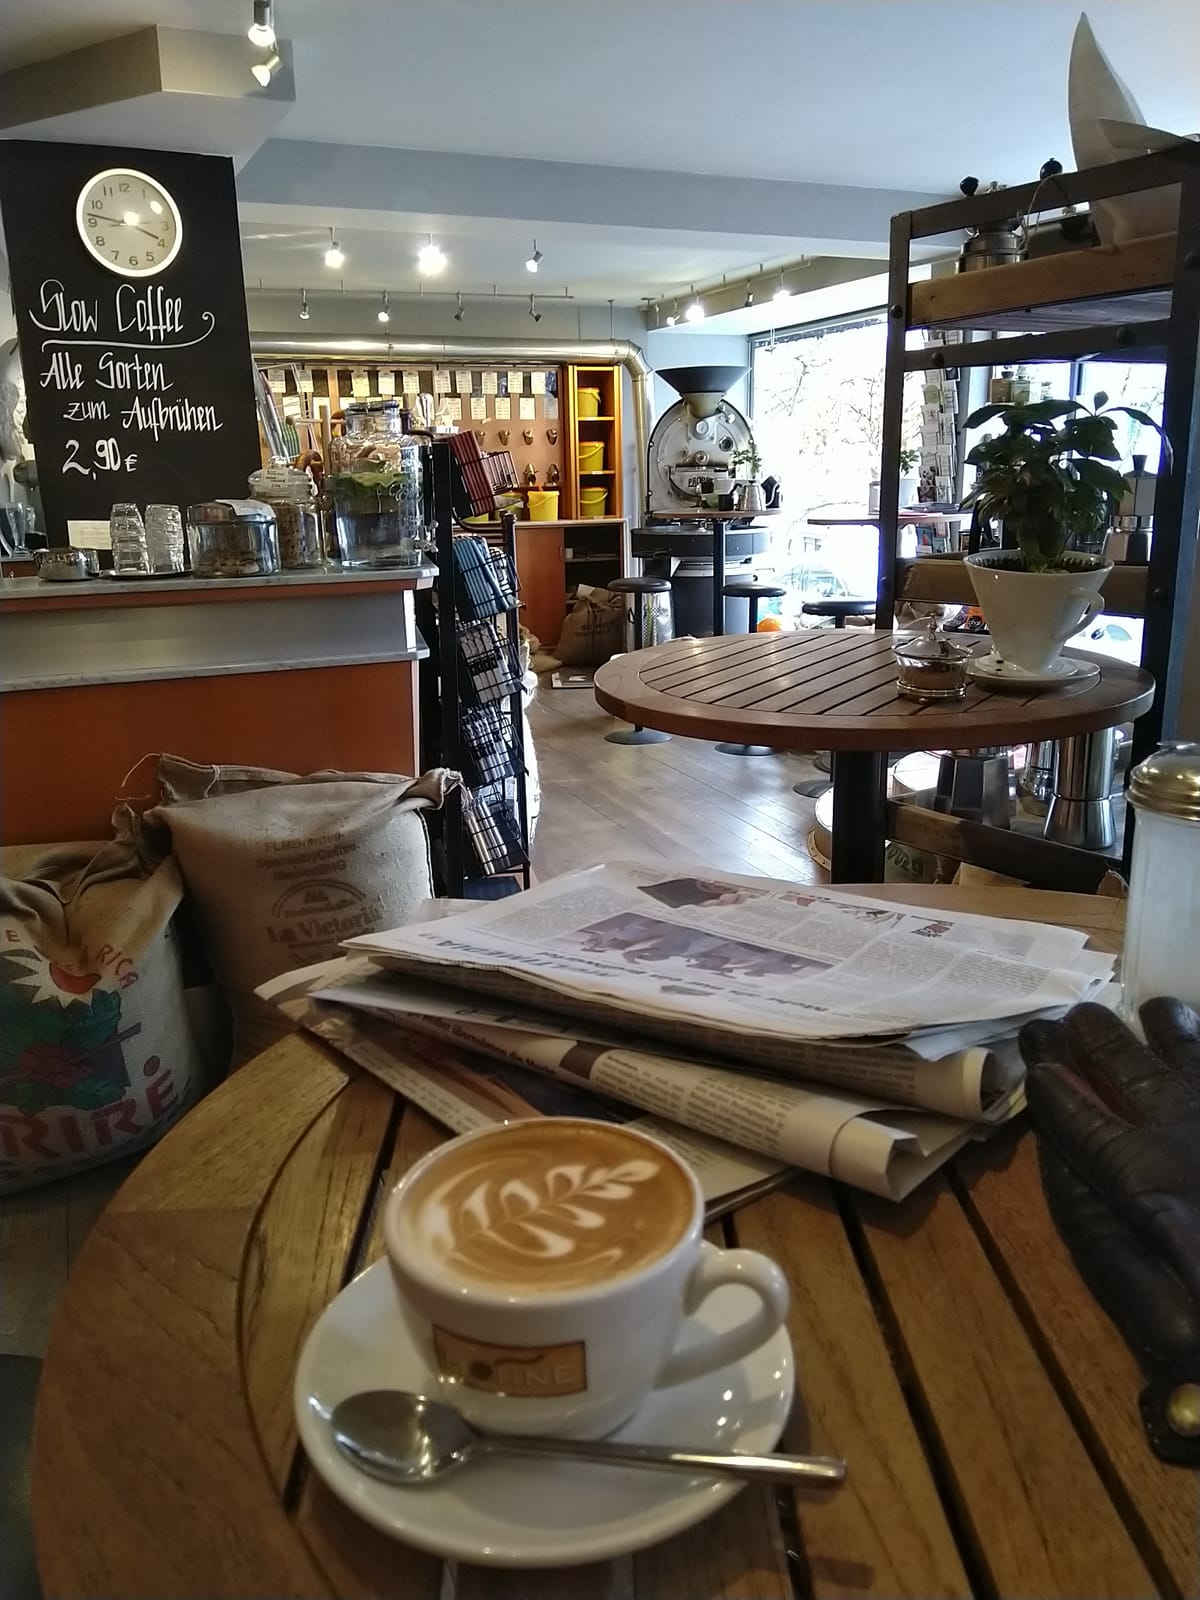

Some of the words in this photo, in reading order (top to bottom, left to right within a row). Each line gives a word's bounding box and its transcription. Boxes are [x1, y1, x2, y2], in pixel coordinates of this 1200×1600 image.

[103, 184, 113, 197] 11
[119, 183, 130, 193] 12
[91, 199, 103, 210] 10
[87, 217, 98, 228] 9
[160, 221, 169, 231] 3
[95, 235, 105, 246] 8
[156, 238, 166, 248] 4
[110, 250, 120, 261] 7
[128, 255, 139, 266] 6
[145, 251, 155, 262] 5
[29, 279, 98, 333] Slow
[116, 284, 184, 342] Coffee
[40, 352, 85, 390] Alle
[95, 352, 174, 392] Sorten
[63, 401, 111, 422] zum
[121, 396, 223, 442] Aufbrühen
